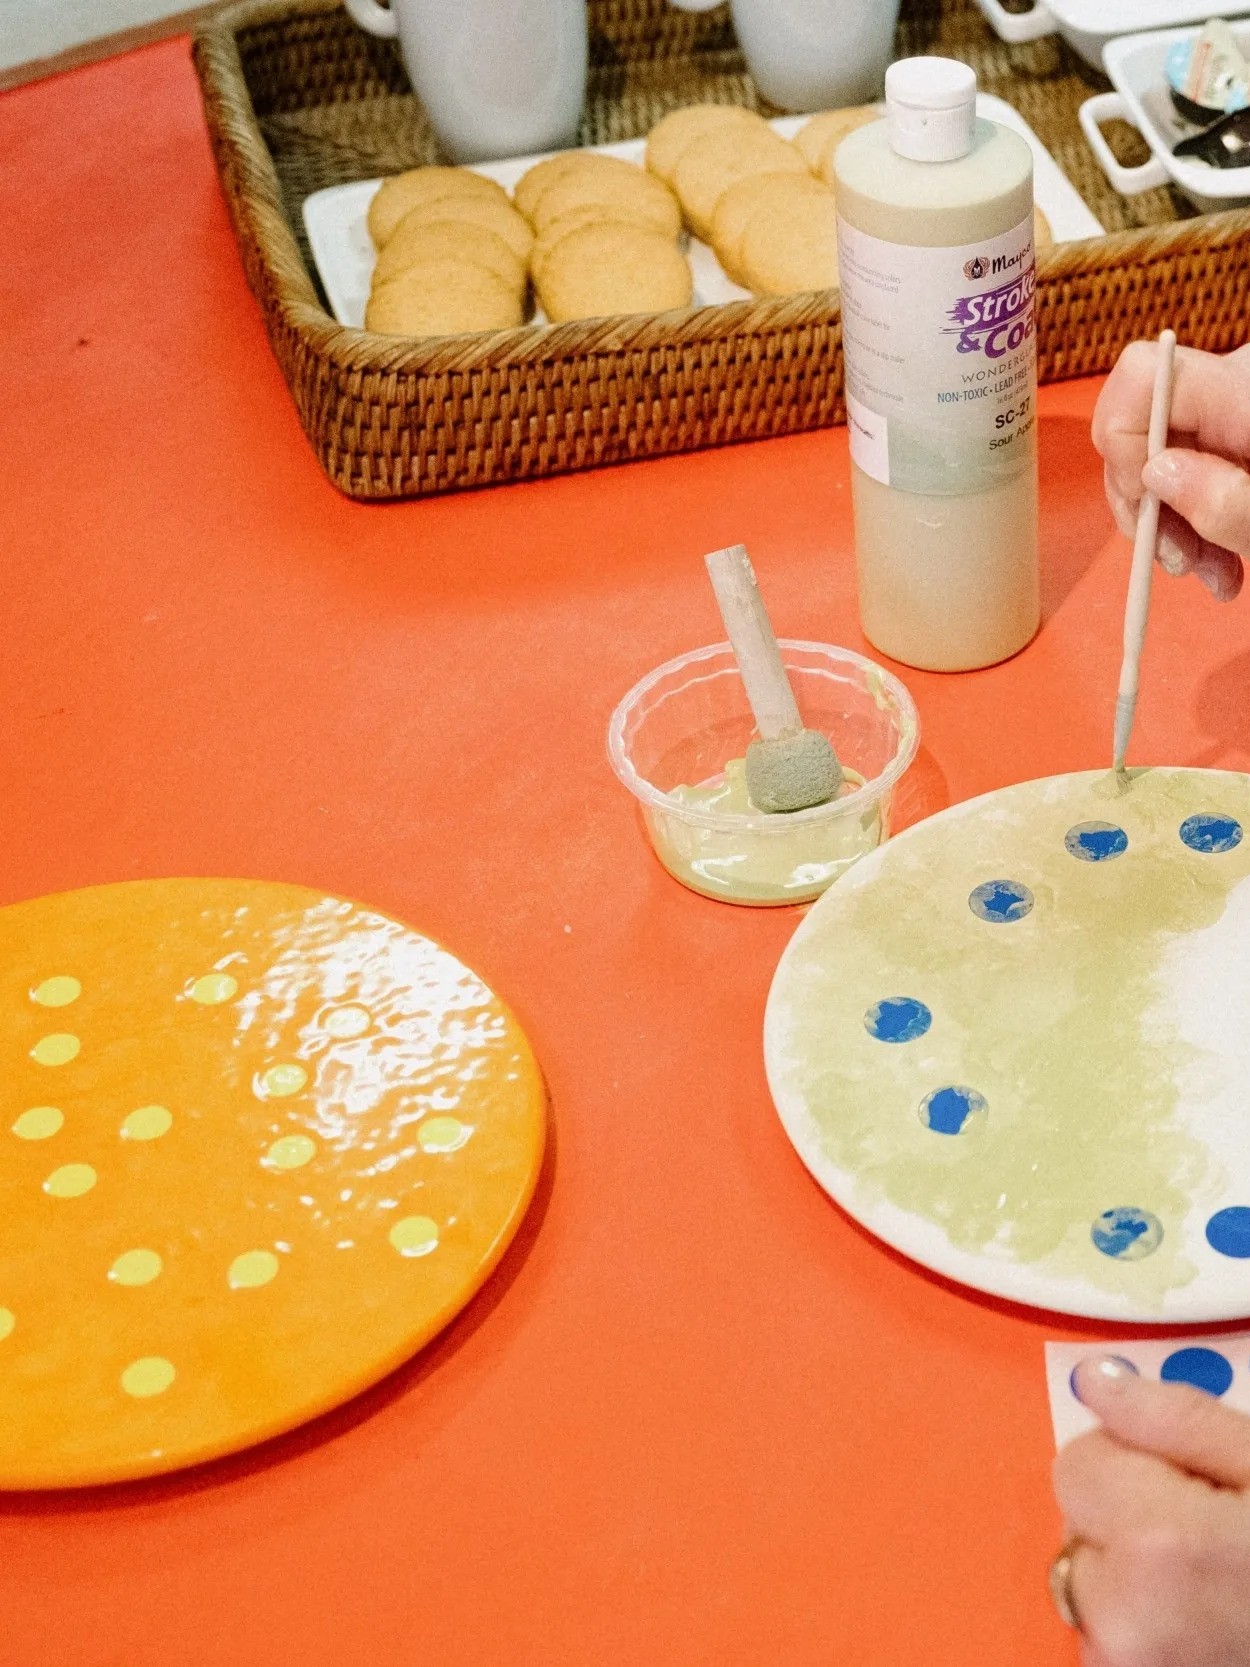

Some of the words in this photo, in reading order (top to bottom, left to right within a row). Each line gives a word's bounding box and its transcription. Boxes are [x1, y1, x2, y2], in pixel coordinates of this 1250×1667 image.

[992, 243, 1031, 274] Mayco
[956, 327, 982, 353] &
[984, 310, 1034, 359] Coa
[937, 386, 988, 403] NON-TOXIC
[994, 377, 1013, 393] LEAD
[1014, 366, 1027, 384] FREE
[995, 396, 1030, 429] SC-27
[989, 433, 1014, 450] Sour
